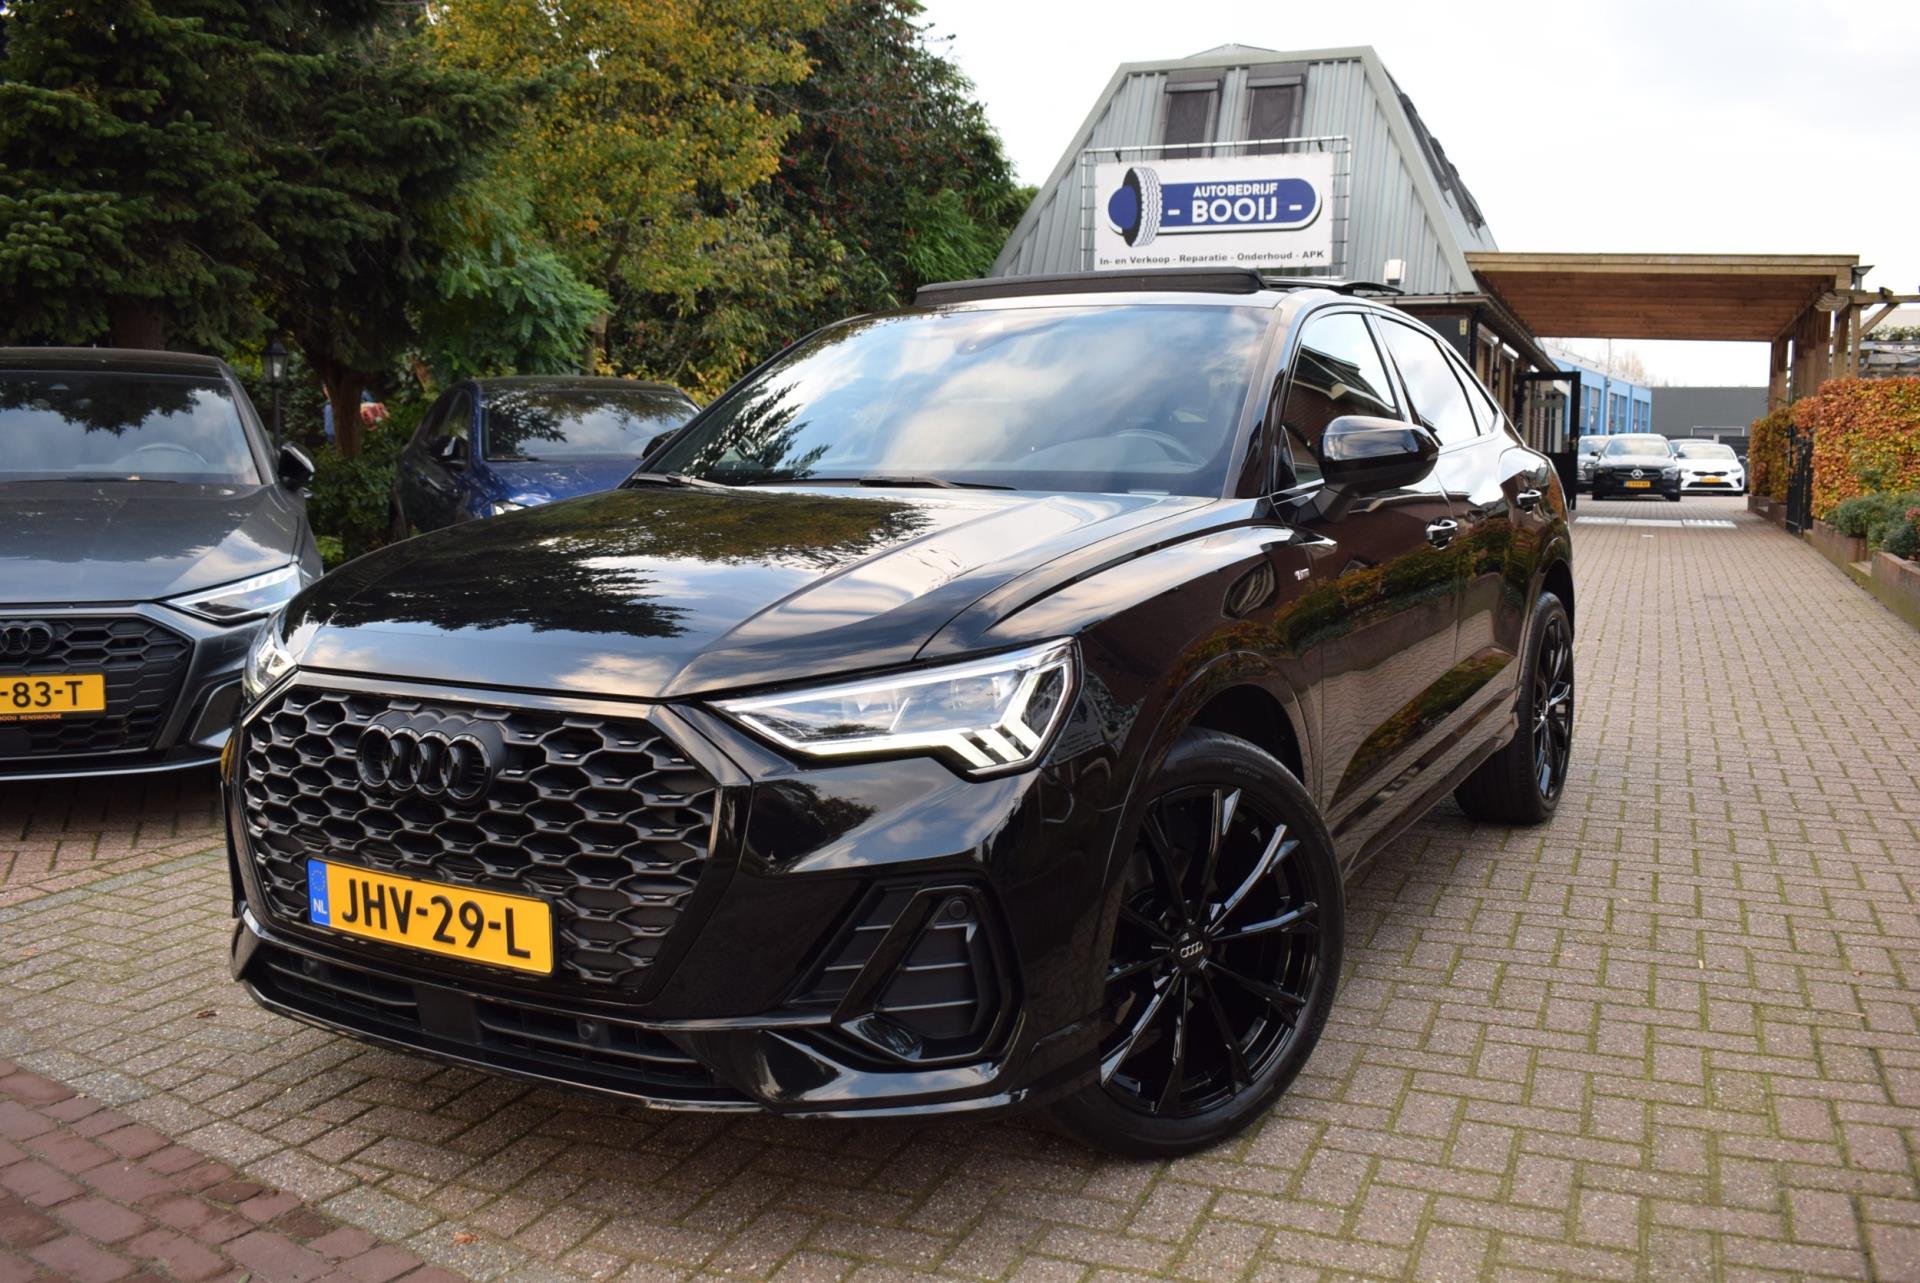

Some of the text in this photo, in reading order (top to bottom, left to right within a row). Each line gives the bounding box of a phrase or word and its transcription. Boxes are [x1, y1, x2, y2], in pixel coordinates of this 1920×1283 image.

[1193, 182, 1279, 198] AUTOBEDRIJF
[1192, 197, 1278, 223] BOOIJ
[1115, 257, 1127, 265] en
[1130, 255, 1170, 265] Verkoop
[1179, 253, 1229, 264] Reparatie
[1236, 251, 1294, 261] Onderhoud
[1302, 249, 1325, 259] APK
[313, 898, 328, 915] NL
[342, 878, 531, 960] JHV-29-L
